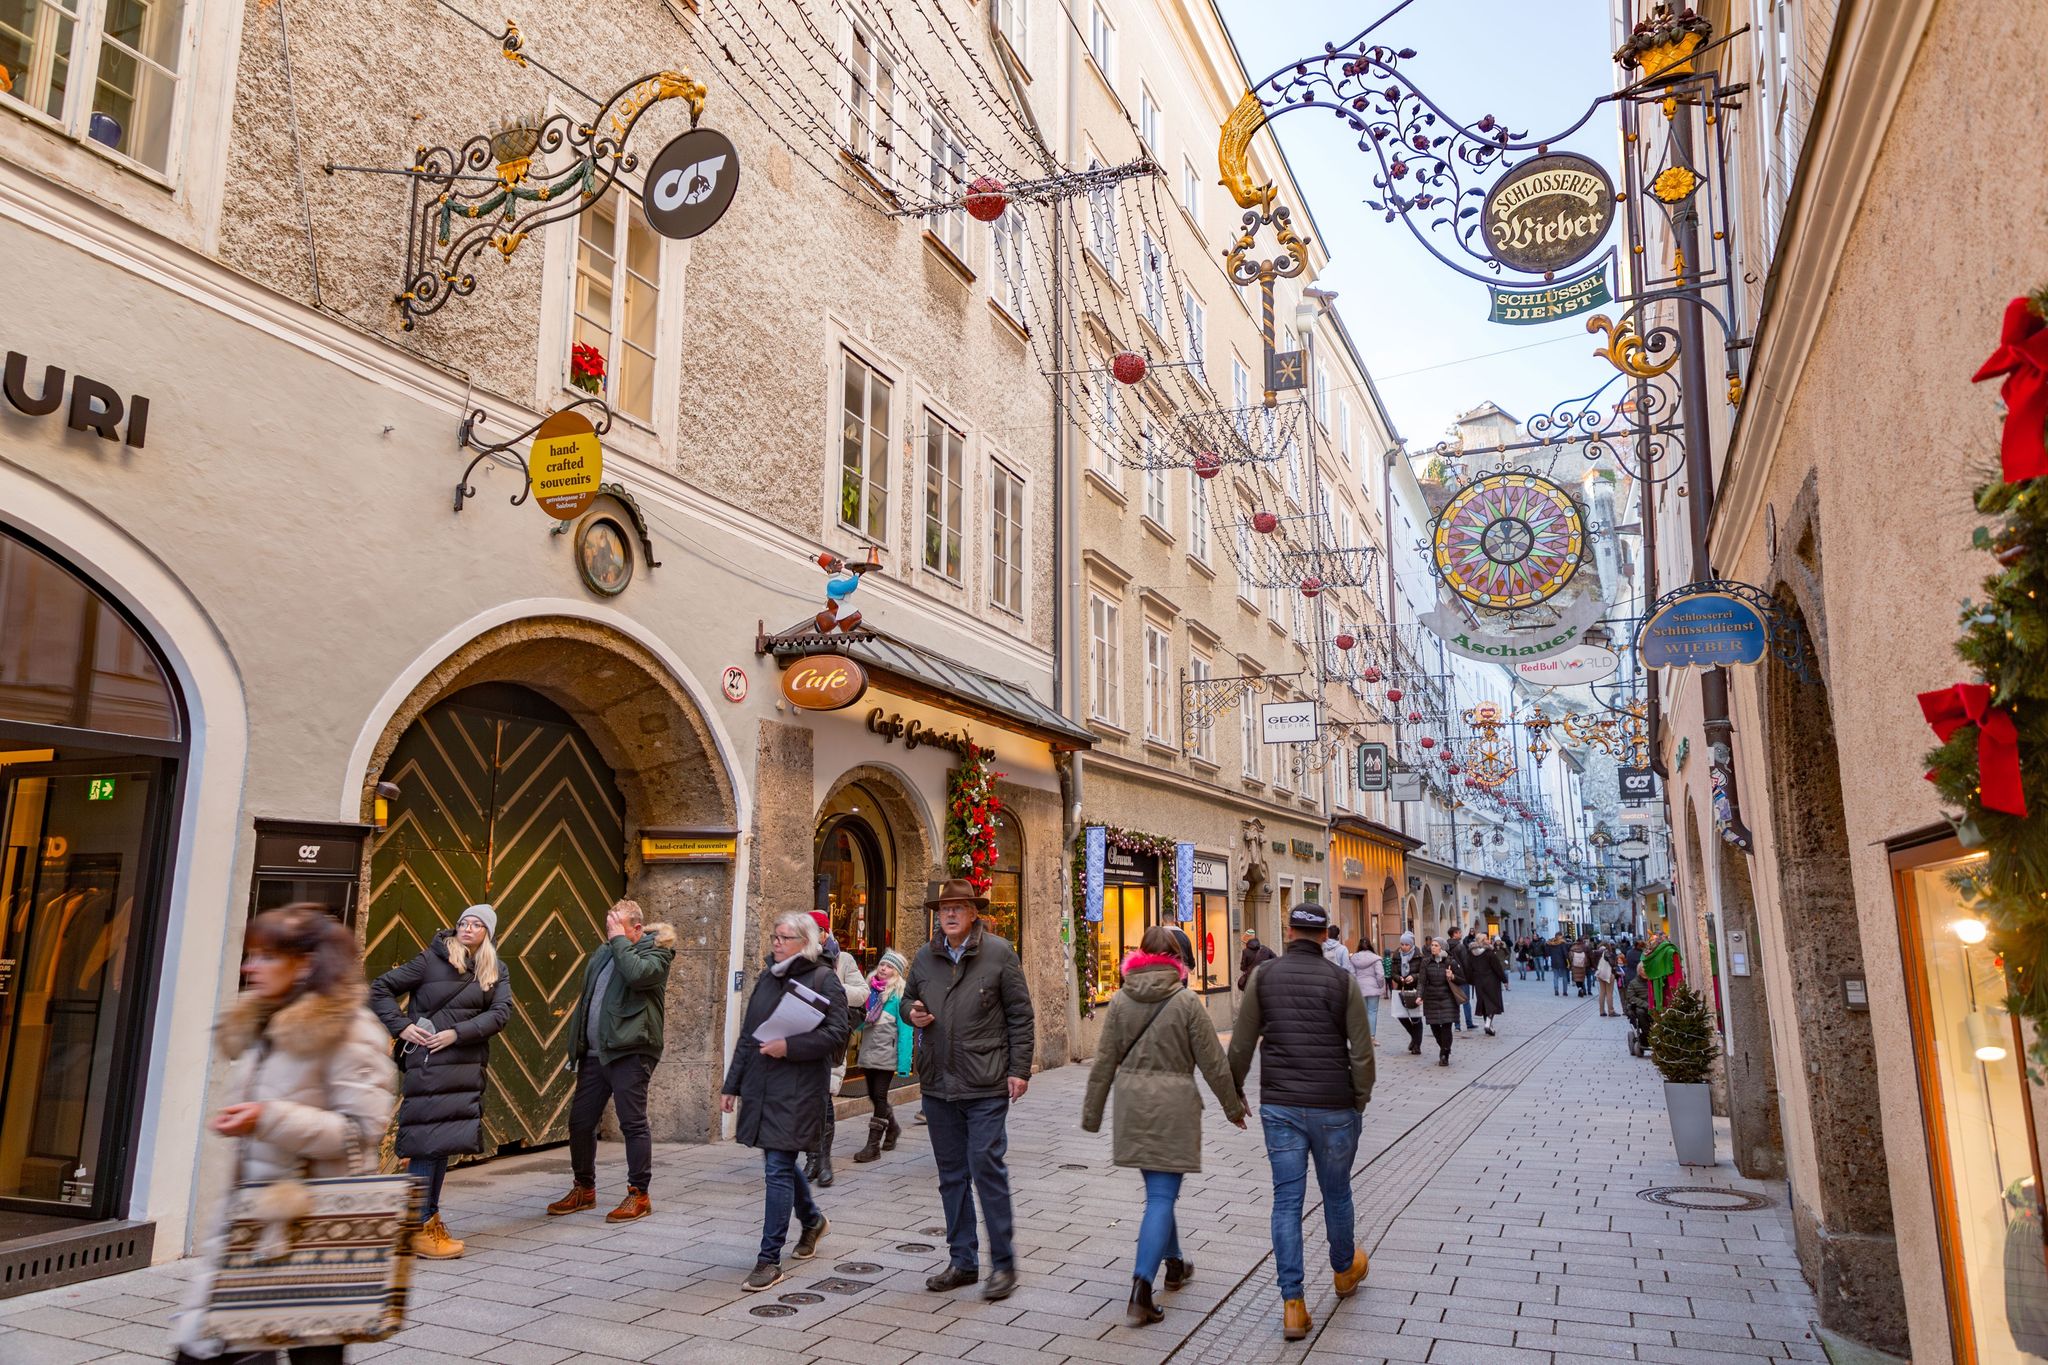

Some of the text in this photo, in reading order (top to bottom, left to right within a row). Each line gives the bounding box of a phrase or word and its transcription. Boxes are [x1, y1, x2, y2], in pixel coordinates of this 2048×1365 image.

[1496, 173, 1599, 212] SCHLOSSEREI
[1491, 210, 1604, 251] Wieber
[1497, 274, 1604, 306] SCHLÜSSEL
[1504, 293, 1592, 320] DIENST
[3, 350, 150, 449] URI
[550, 441, 580, 456] hand-
[546, 456, 584, 472] crafted
[540, 473, 591, 489] souvenirs
[1672, 610, 1734, 622] Schlosserei
[1653, 621, 1755, 637] Schlüsseldienst
[1451, 625, 1578, 657] Aschauer
[1665, 640, 1743, 654] WIEBER
[729, 669, 742, 690] 27
[791, 668, 848, 691] Café
[866, 707, 904, 743] Café
[1268, 714, 1310, 724] GEOX
